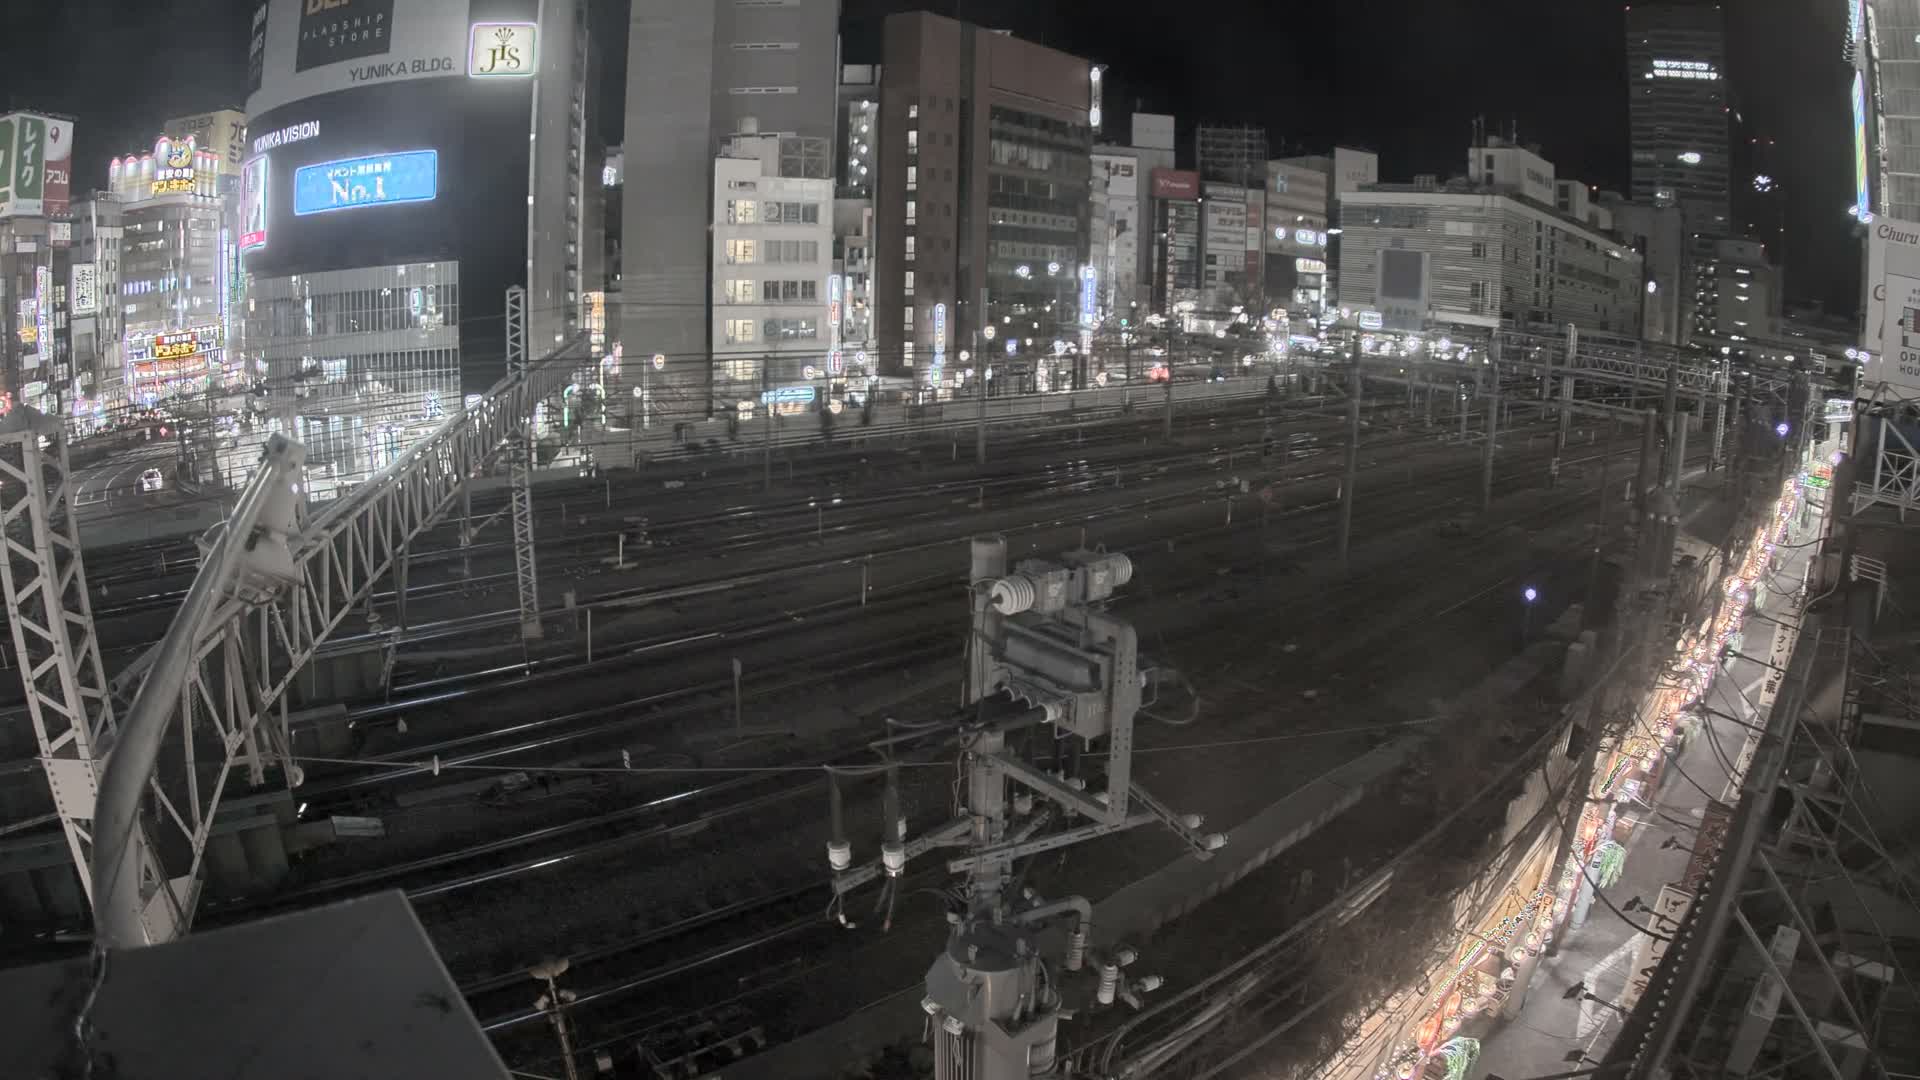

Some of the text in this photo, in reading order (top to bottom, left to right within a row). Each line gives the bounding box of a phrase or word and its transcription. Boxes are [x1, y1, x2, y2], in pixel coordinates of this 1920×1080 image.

[303, 12, 384, 41] FLAGSHIP
[329, 28, 383, 47] STORE
[350, 57, 456, 81] YUNIKA BLDG.
[254, 119, 320, 153] YUNIKA VISION
[22, 121, 37, 187] レイク
[45, 168, 69, 185] アコム
[331, 176, 388, 205] No.1
